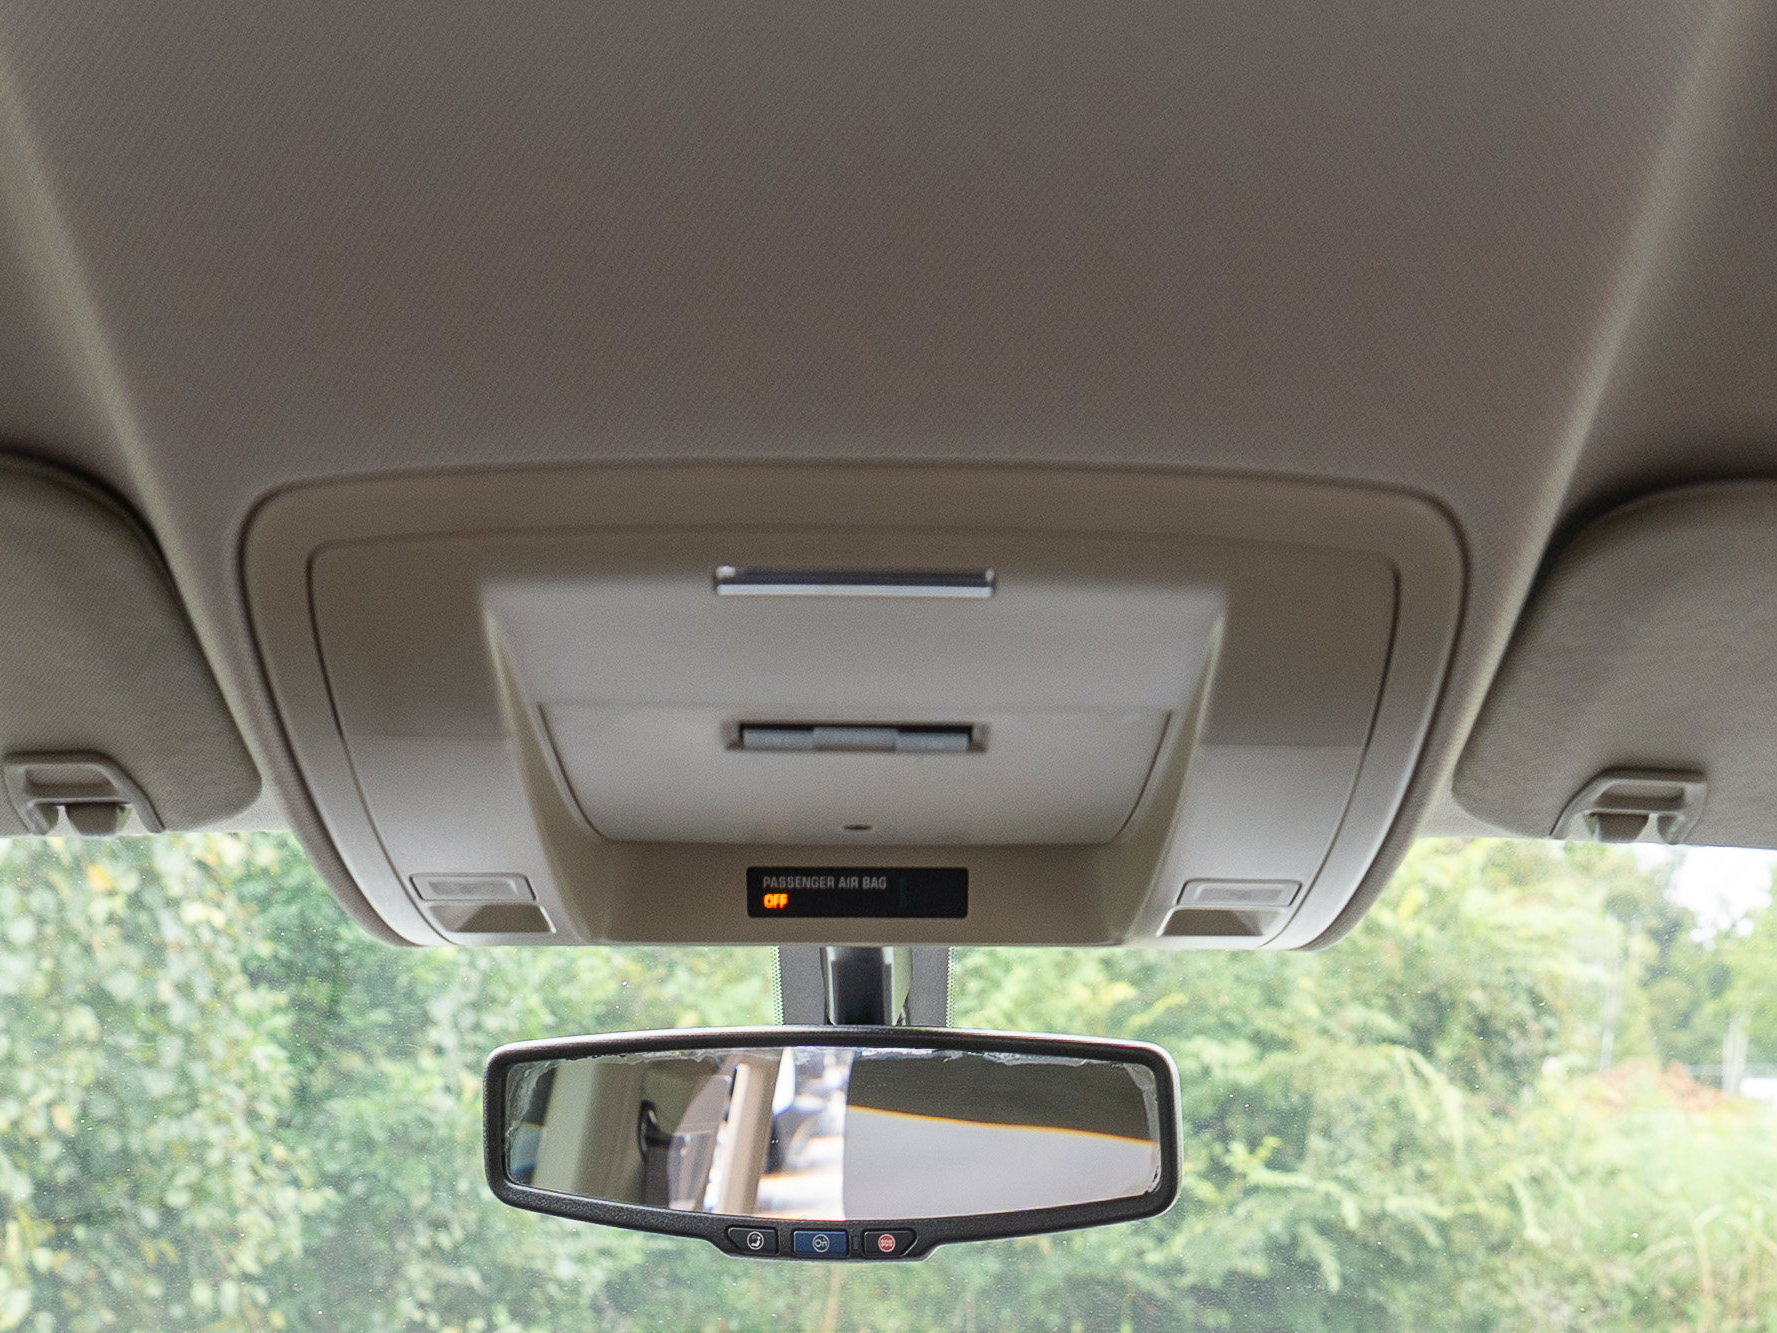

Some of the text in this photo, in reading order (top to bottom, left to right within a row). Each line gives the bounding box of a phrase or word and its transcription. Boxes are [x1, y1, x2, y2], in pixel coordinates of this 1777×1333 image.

[763, 876, 887, 890] PASSENGER AIR BAG
[763, 893, 789, 909] OFF
[813, 1237, 827, 1248] On
